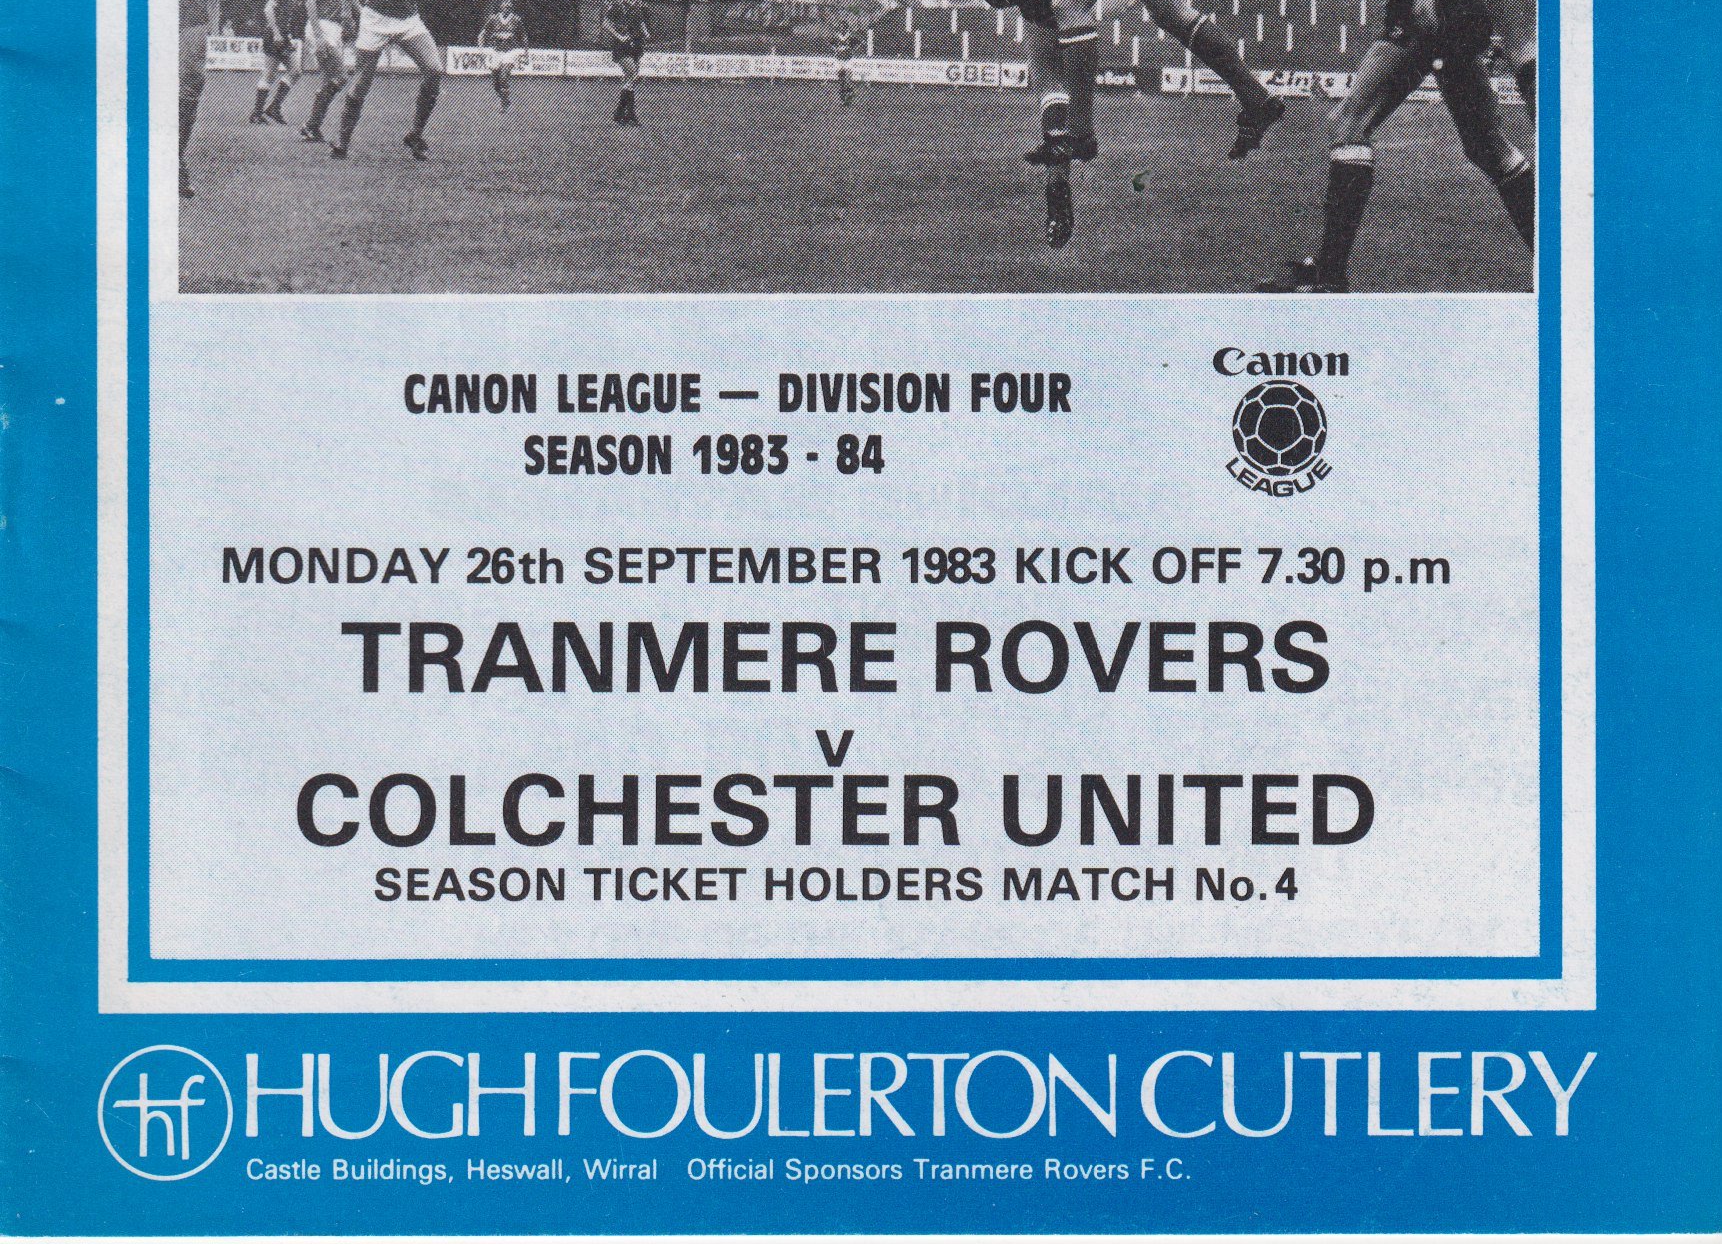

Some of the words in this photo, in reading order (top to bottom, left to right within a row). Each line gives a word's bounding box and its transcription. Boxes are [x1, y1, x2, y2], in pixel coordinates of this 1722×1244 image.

[945, 63, 997, 84] GBE
[1212, 346, 1349, 377] Canon
[404, 373, 537, 414] CANON
[558, 373, 701, 414] LEAGUE
[779, 372, 950, 413] DIVISION
[971, 372, 1071, 413] FOUR
[524, 434, 672, 475] SEASON
[693, 434, 789, 475] 1983
[836, 433, 885, 475] 84
[1224, 456, 1333, 498] LEAGUE
[222, 546, 450, 584] MONDAY
[467, 547, 564, 584] 26th
[584, 547, 881, 584] SEPTEMBER
[902, 547, 996, 584] 1983
[1016, 546, 1132, 584] KICK
[1152, 546, 1242, 584] OFF
[1258, 547, 1345, 584] 7.30
[1364, 558, 1450, 593] p.m
[341, 621, 897, 693] TRANMERE
[935, 620, 1330, 694] ROVERS
[297, 773, 960, 848] COLCHESTER
[1003, 774, 1375, 847] UNITED
[375, 867, 565, 902] SEASON
[583, 867, 747, 901] TICKET
[765, 867, 983, 902] HOLDERS
[1003, 867, 1174, 901] MATCH
[246, 1050, 536, 1140] HUGH
[558, 1049, 1117, 1140] FOULERTON
[1140, 1050, 1598, 1138] CUTLERY
[246, 1158, 321, 1181] Castle
[333, 1158, 454, 1185] Buildings,
[467, 1158, 571, 1183] Heswall,
[583, 1158, 658, 1180] Wirral
[687, 1158, 775, 1180] Official
[785, 1158, 903, 1185] Sponsors
[913, 1158, 1034, 1180] Tranmere
[1045, 1158, 1130, 1180] Rovers
[1141, 1158, 1192, 1180] F.C.
